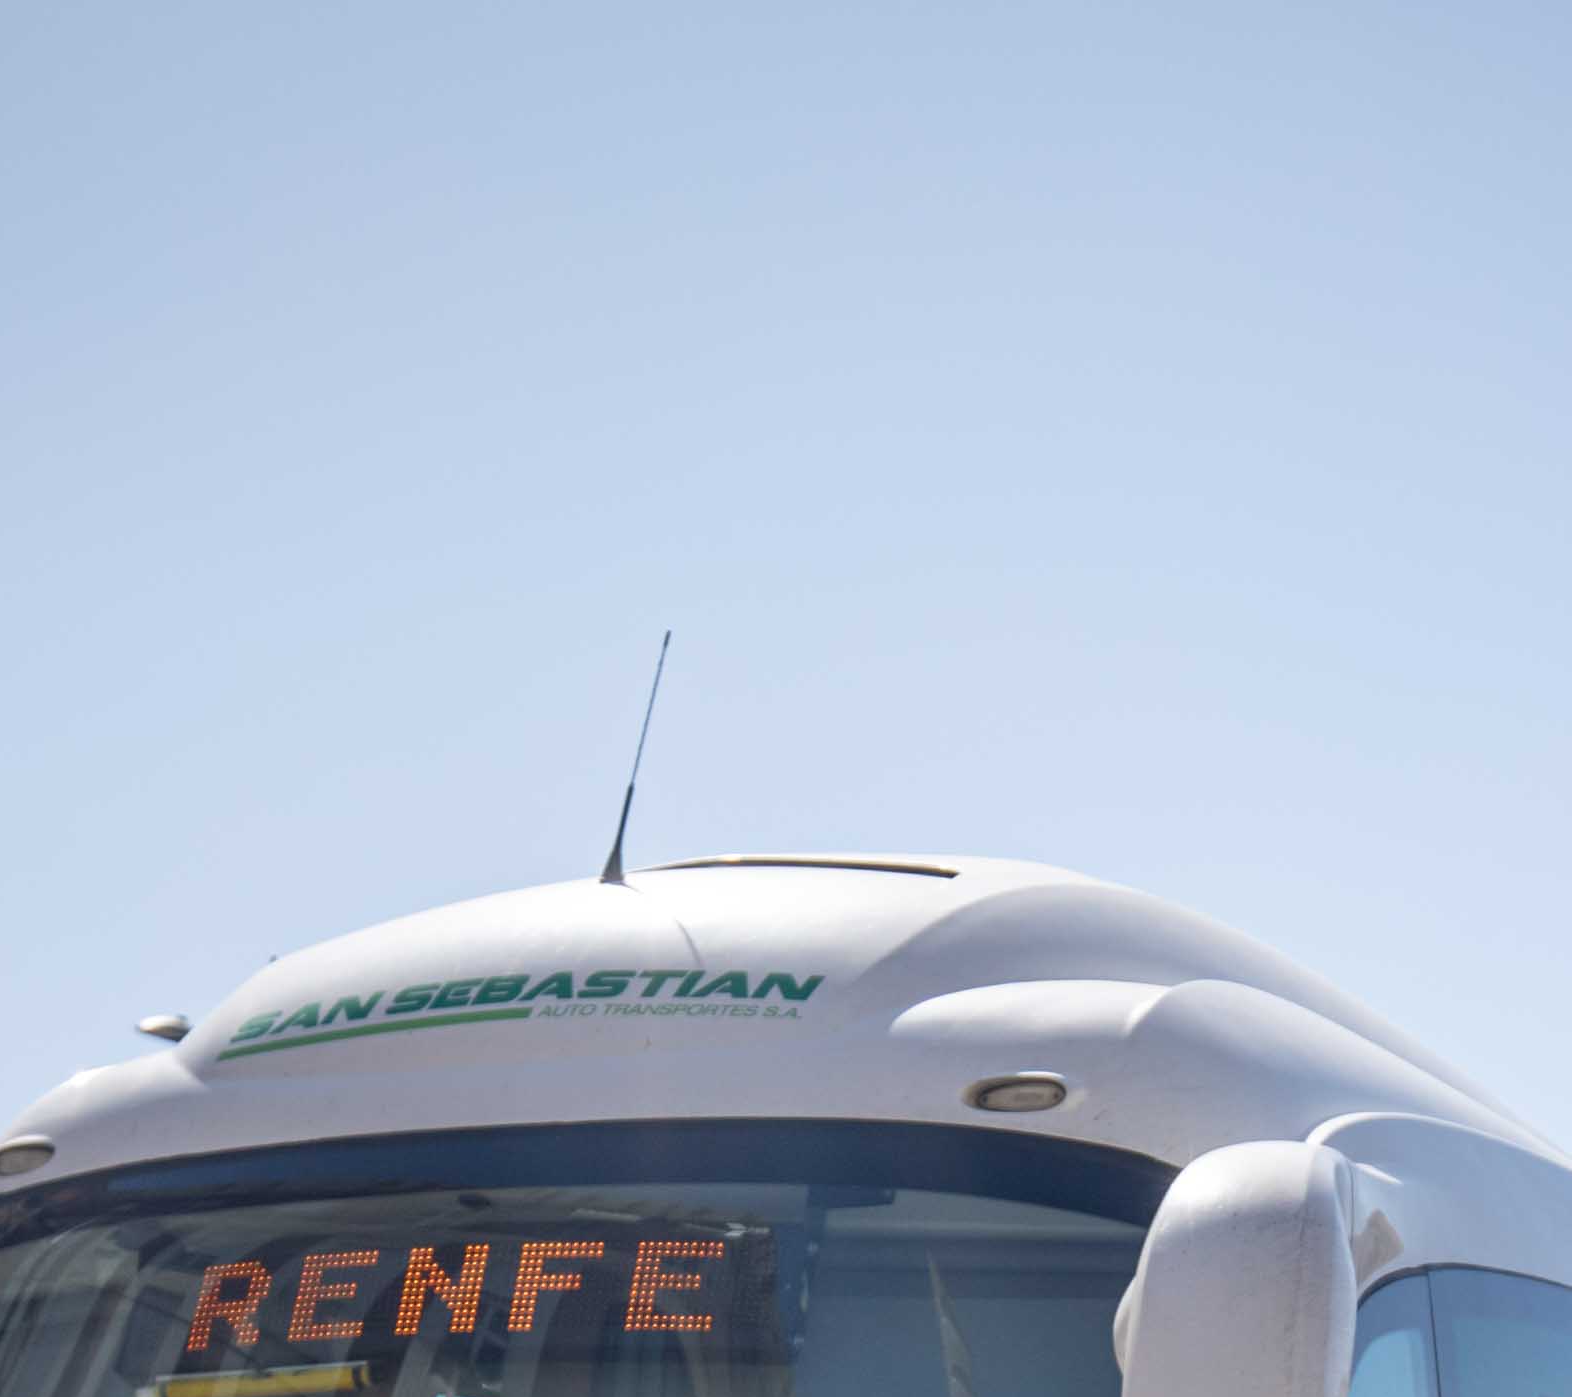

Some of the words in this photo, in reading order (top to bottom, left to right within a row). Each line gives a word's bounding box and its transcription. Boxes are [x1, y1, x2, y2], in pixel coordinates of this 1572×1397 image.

[230, 989, 388, 1044] SAN
[385, 969, 826, 1015] SEBASTIAN
[538, 1003, 596, 1018] AUTO
[601, 1003, 760, 1017] TRANSPORTES
[762, 1005, 803, 1019] S.A.
[185, 1239, 725, 1352] RENFE
